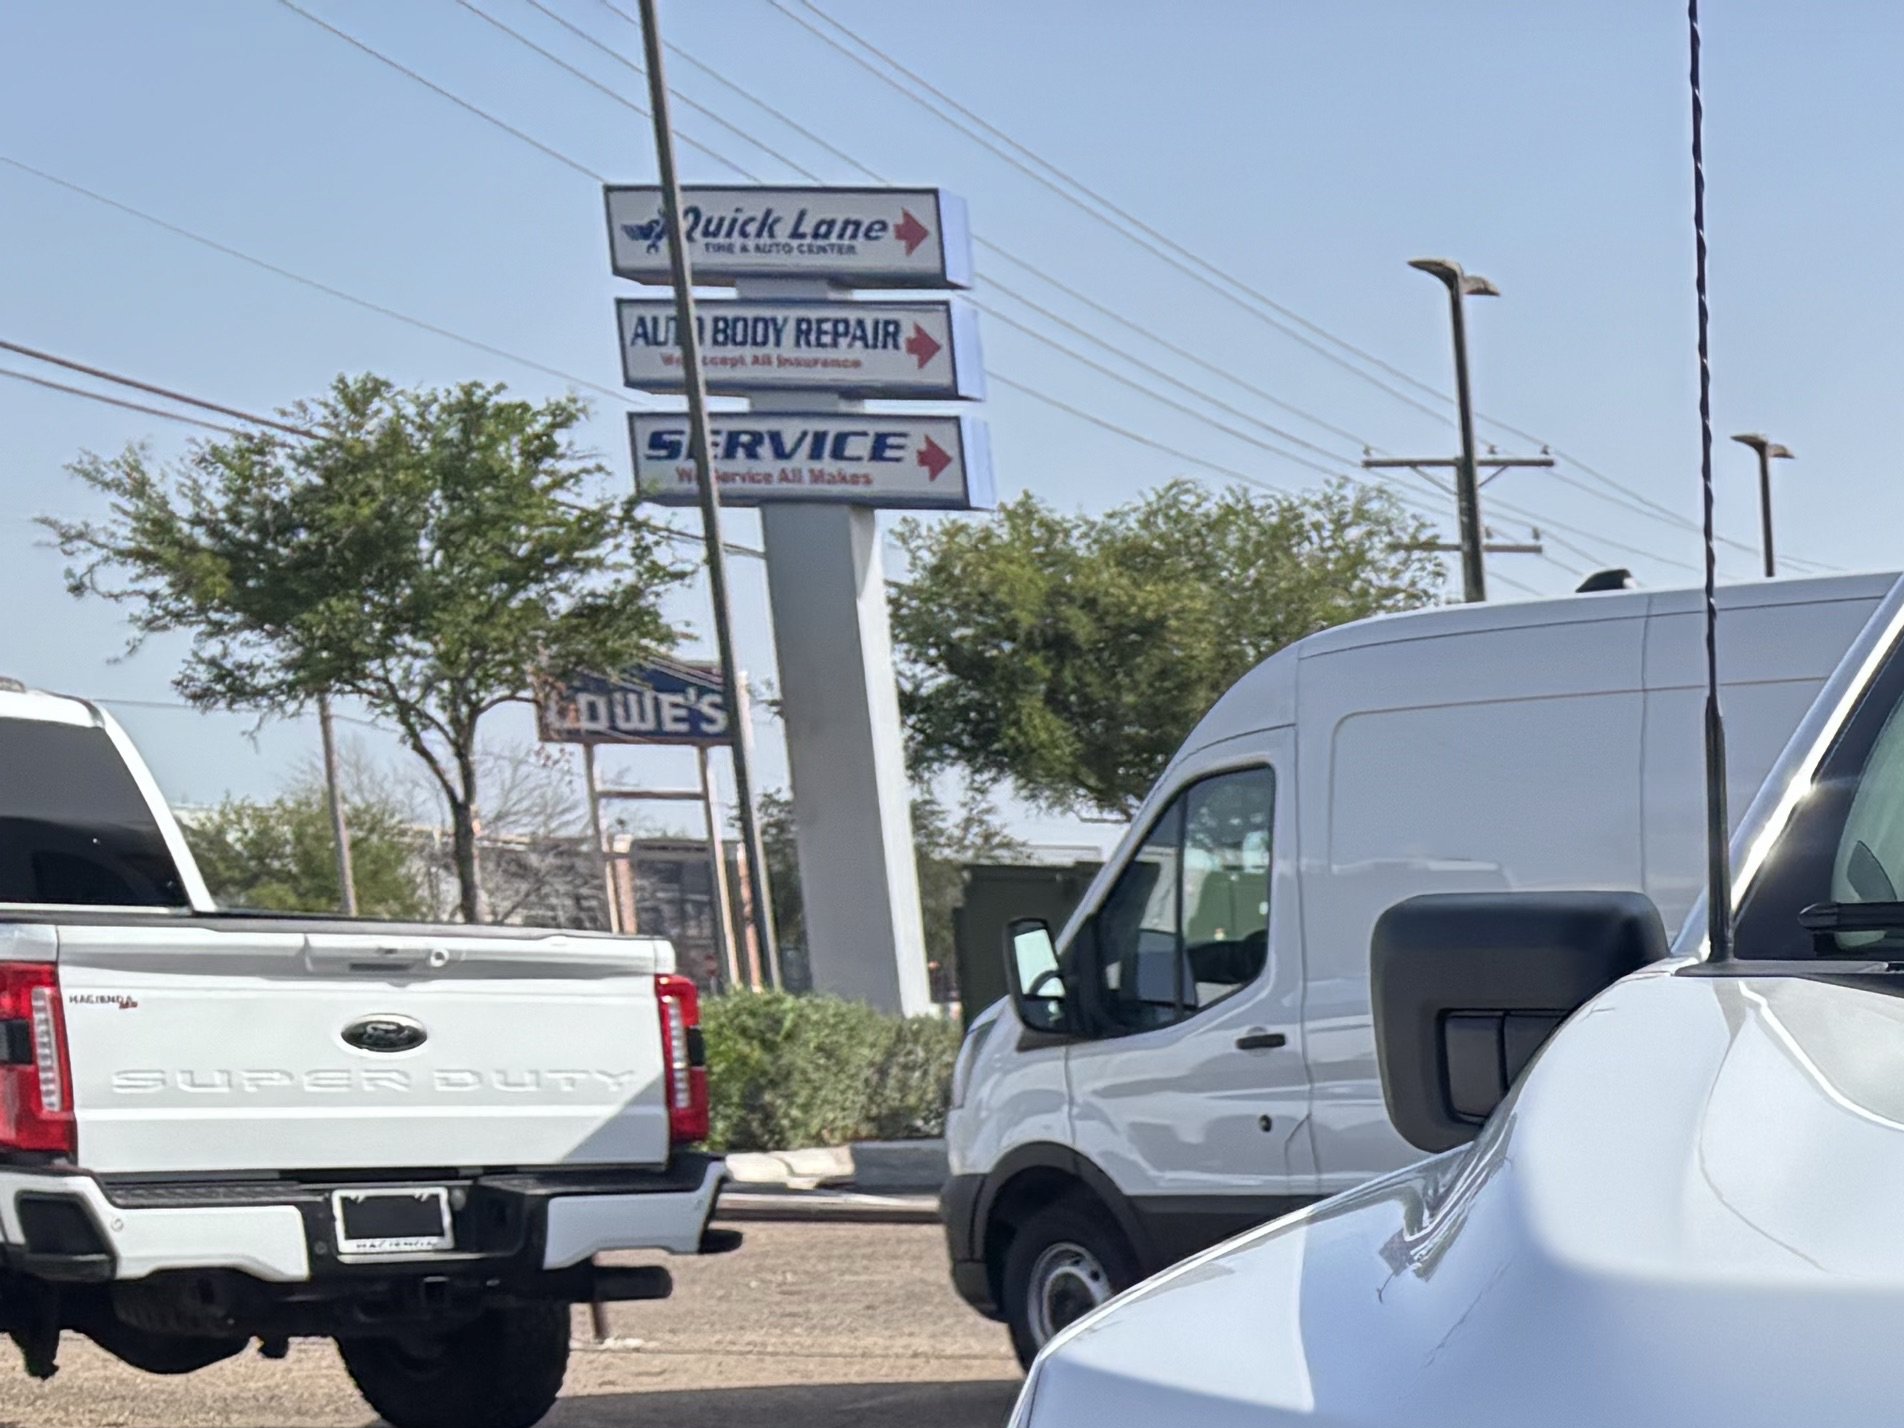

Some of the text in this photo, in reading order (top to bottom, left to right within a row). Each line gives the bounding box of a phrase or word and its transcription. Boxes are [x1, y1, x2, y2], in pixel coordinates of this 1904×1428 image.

[787, 207, 889, 241] Lane
[712, 316, 788, 347] BODY
[794, 317, 901, 350] REPAIR
[112, 1069, 635, 1093] SUPER DUTY
